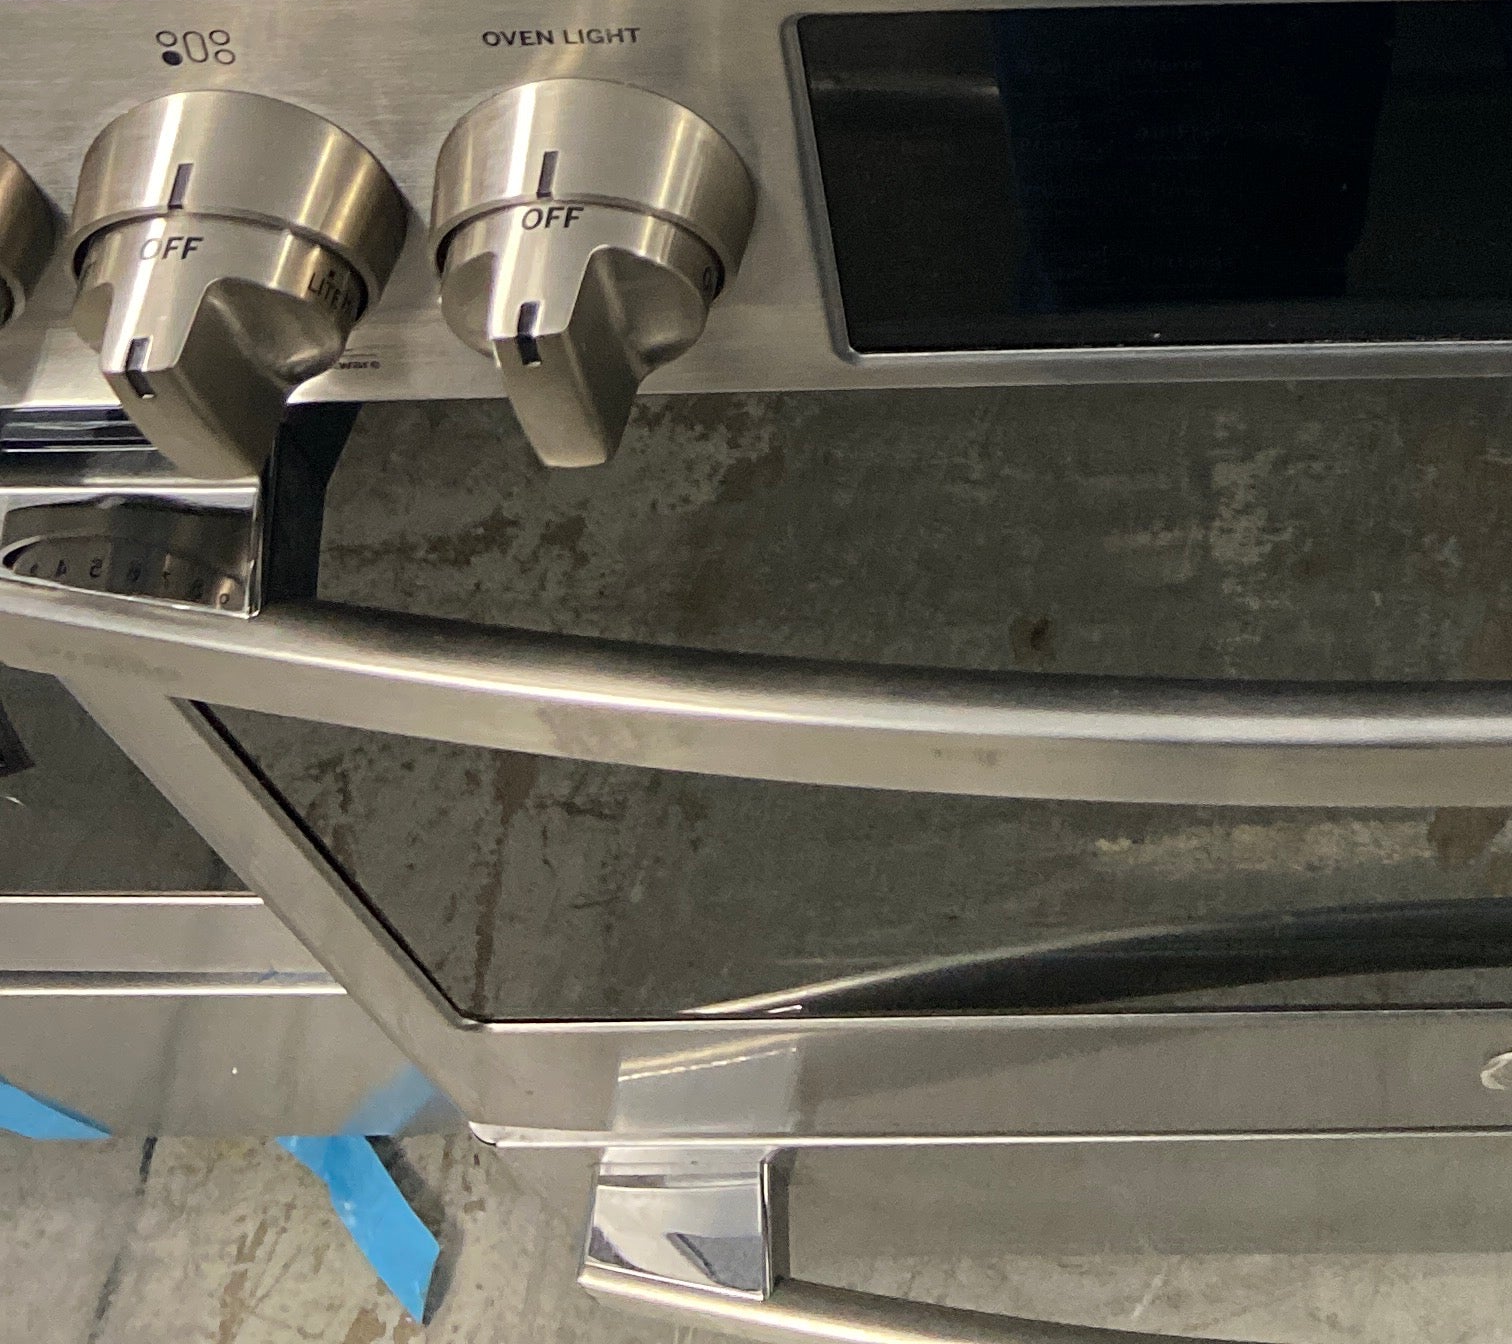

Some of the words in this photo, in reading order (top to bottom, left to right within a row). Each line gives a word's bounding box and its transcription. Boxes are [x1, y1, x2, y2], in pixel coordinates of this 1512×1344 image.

[482, 29, 555, 47] OVEN
[563, 27, 641, 45] LIGHT
[520, 206, 585, 231] OFF
[138, 236, 205, 261] OFF
